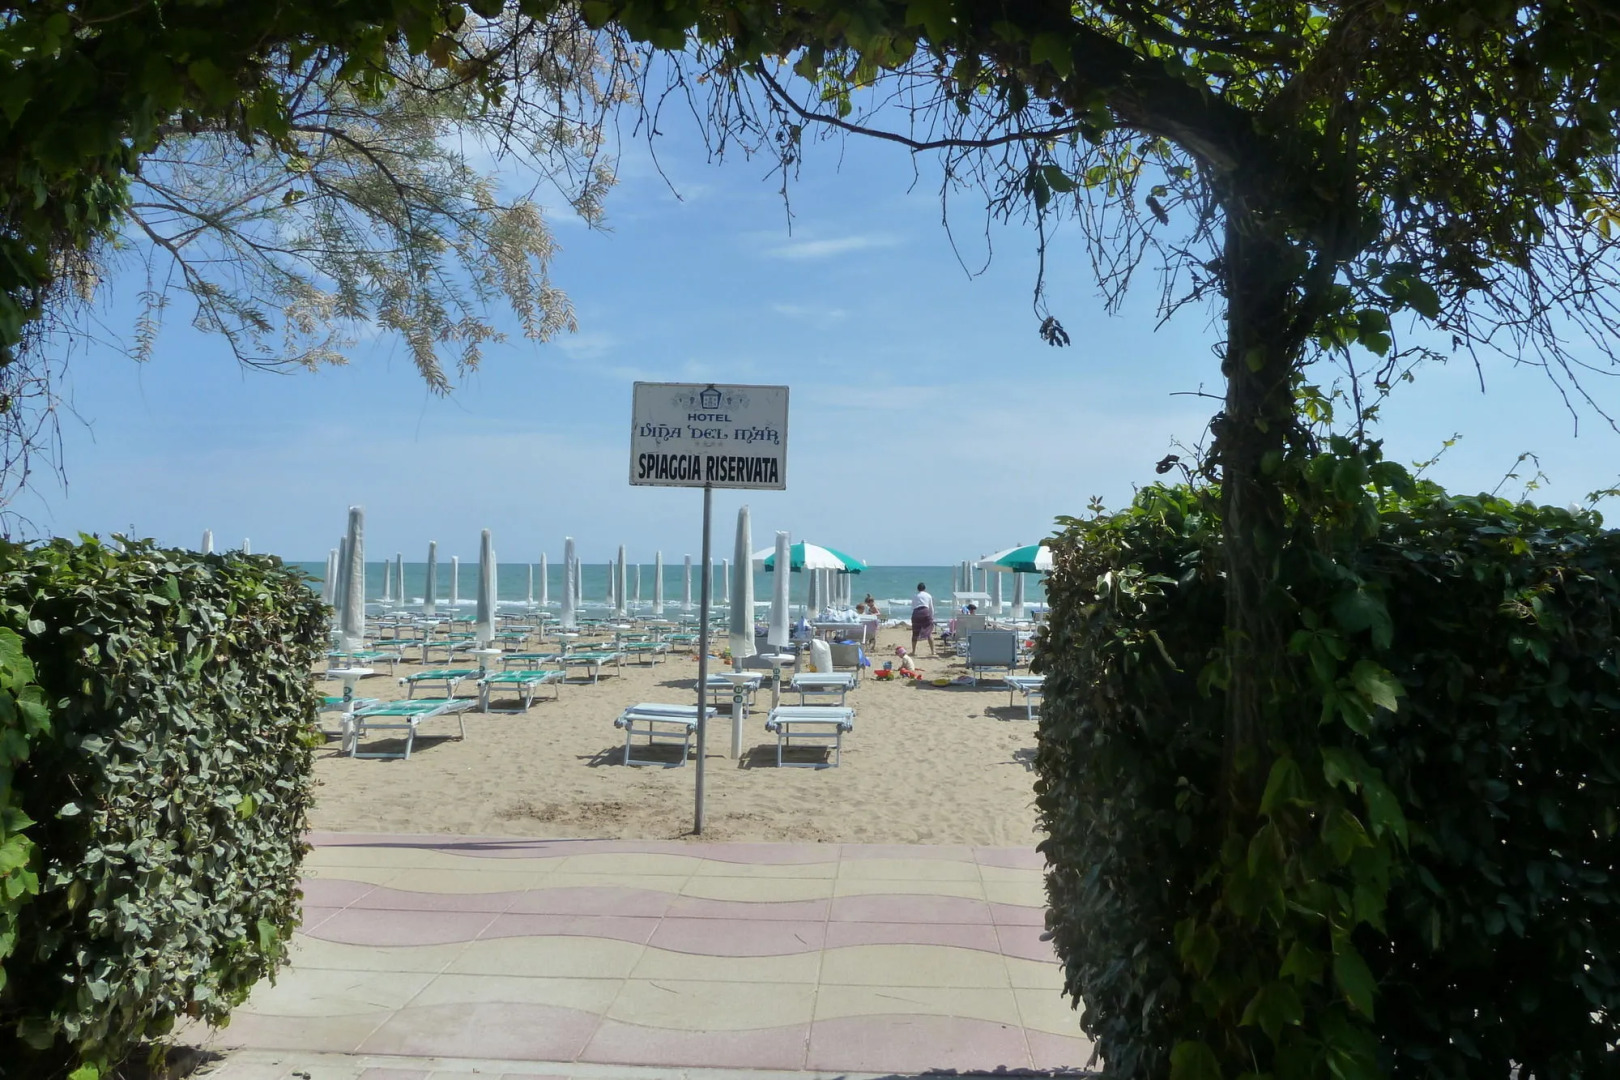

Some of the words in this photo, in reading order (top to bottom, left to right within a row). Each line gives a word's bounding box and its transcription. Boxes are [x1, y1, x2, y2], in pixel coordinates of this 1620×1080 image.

[687, 413, 732, 422] HOTEL
[687, 425, 728, 439] DEL
[734, 426, 780, 445] MAR
[638, 453, 702, 481] SPIAGGIA
[706, 455, 779, 483] RISERVATA
